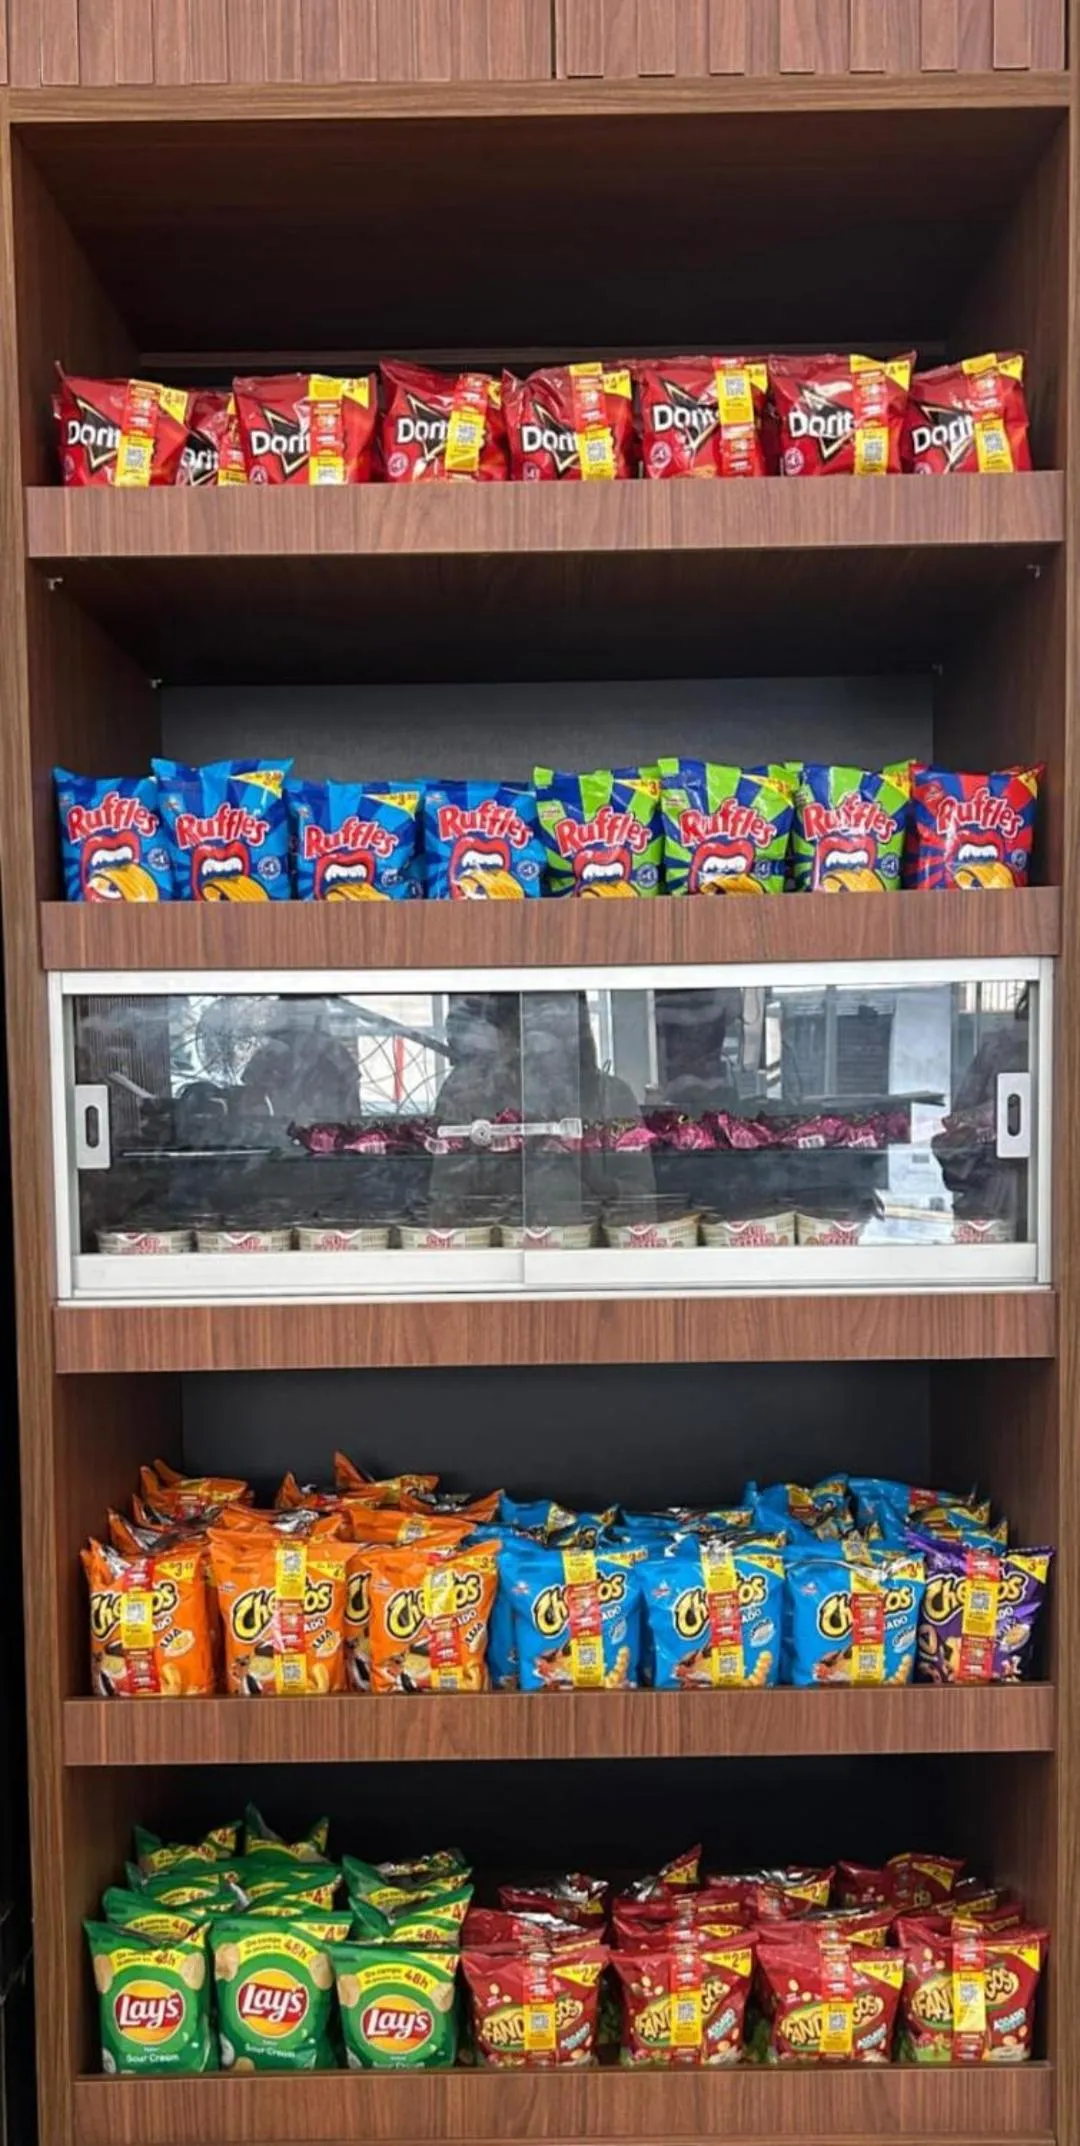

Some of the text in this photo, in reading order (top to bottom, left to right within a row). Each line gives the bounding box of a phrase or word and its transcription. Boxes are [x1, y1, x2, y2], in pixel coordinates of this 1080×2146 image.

[788, 410, 855, 440] Dorit
[911, 415, 973, 454] Dorit
[67, 791, 159, 845] Ruffles
[176, 802, 270, 850] Ruffles
[437, 800, 533, 849] Ruffles
[555, 806, 652, 857] Ruffles
[679, 798, 777, 849] Ruffles
[803, 791, 897, 843] Ruffles
[936, 787, 1024, 839] Ruffles
[304, 816, 399, 860] Ruffles
[924, 1573, 1026, 1624] Cheos
[119, 1992, 181, 2030] Lay's
[241, 1980, 306, 2022] Lay's
[366, 2007, 431, 2040] Lay's
